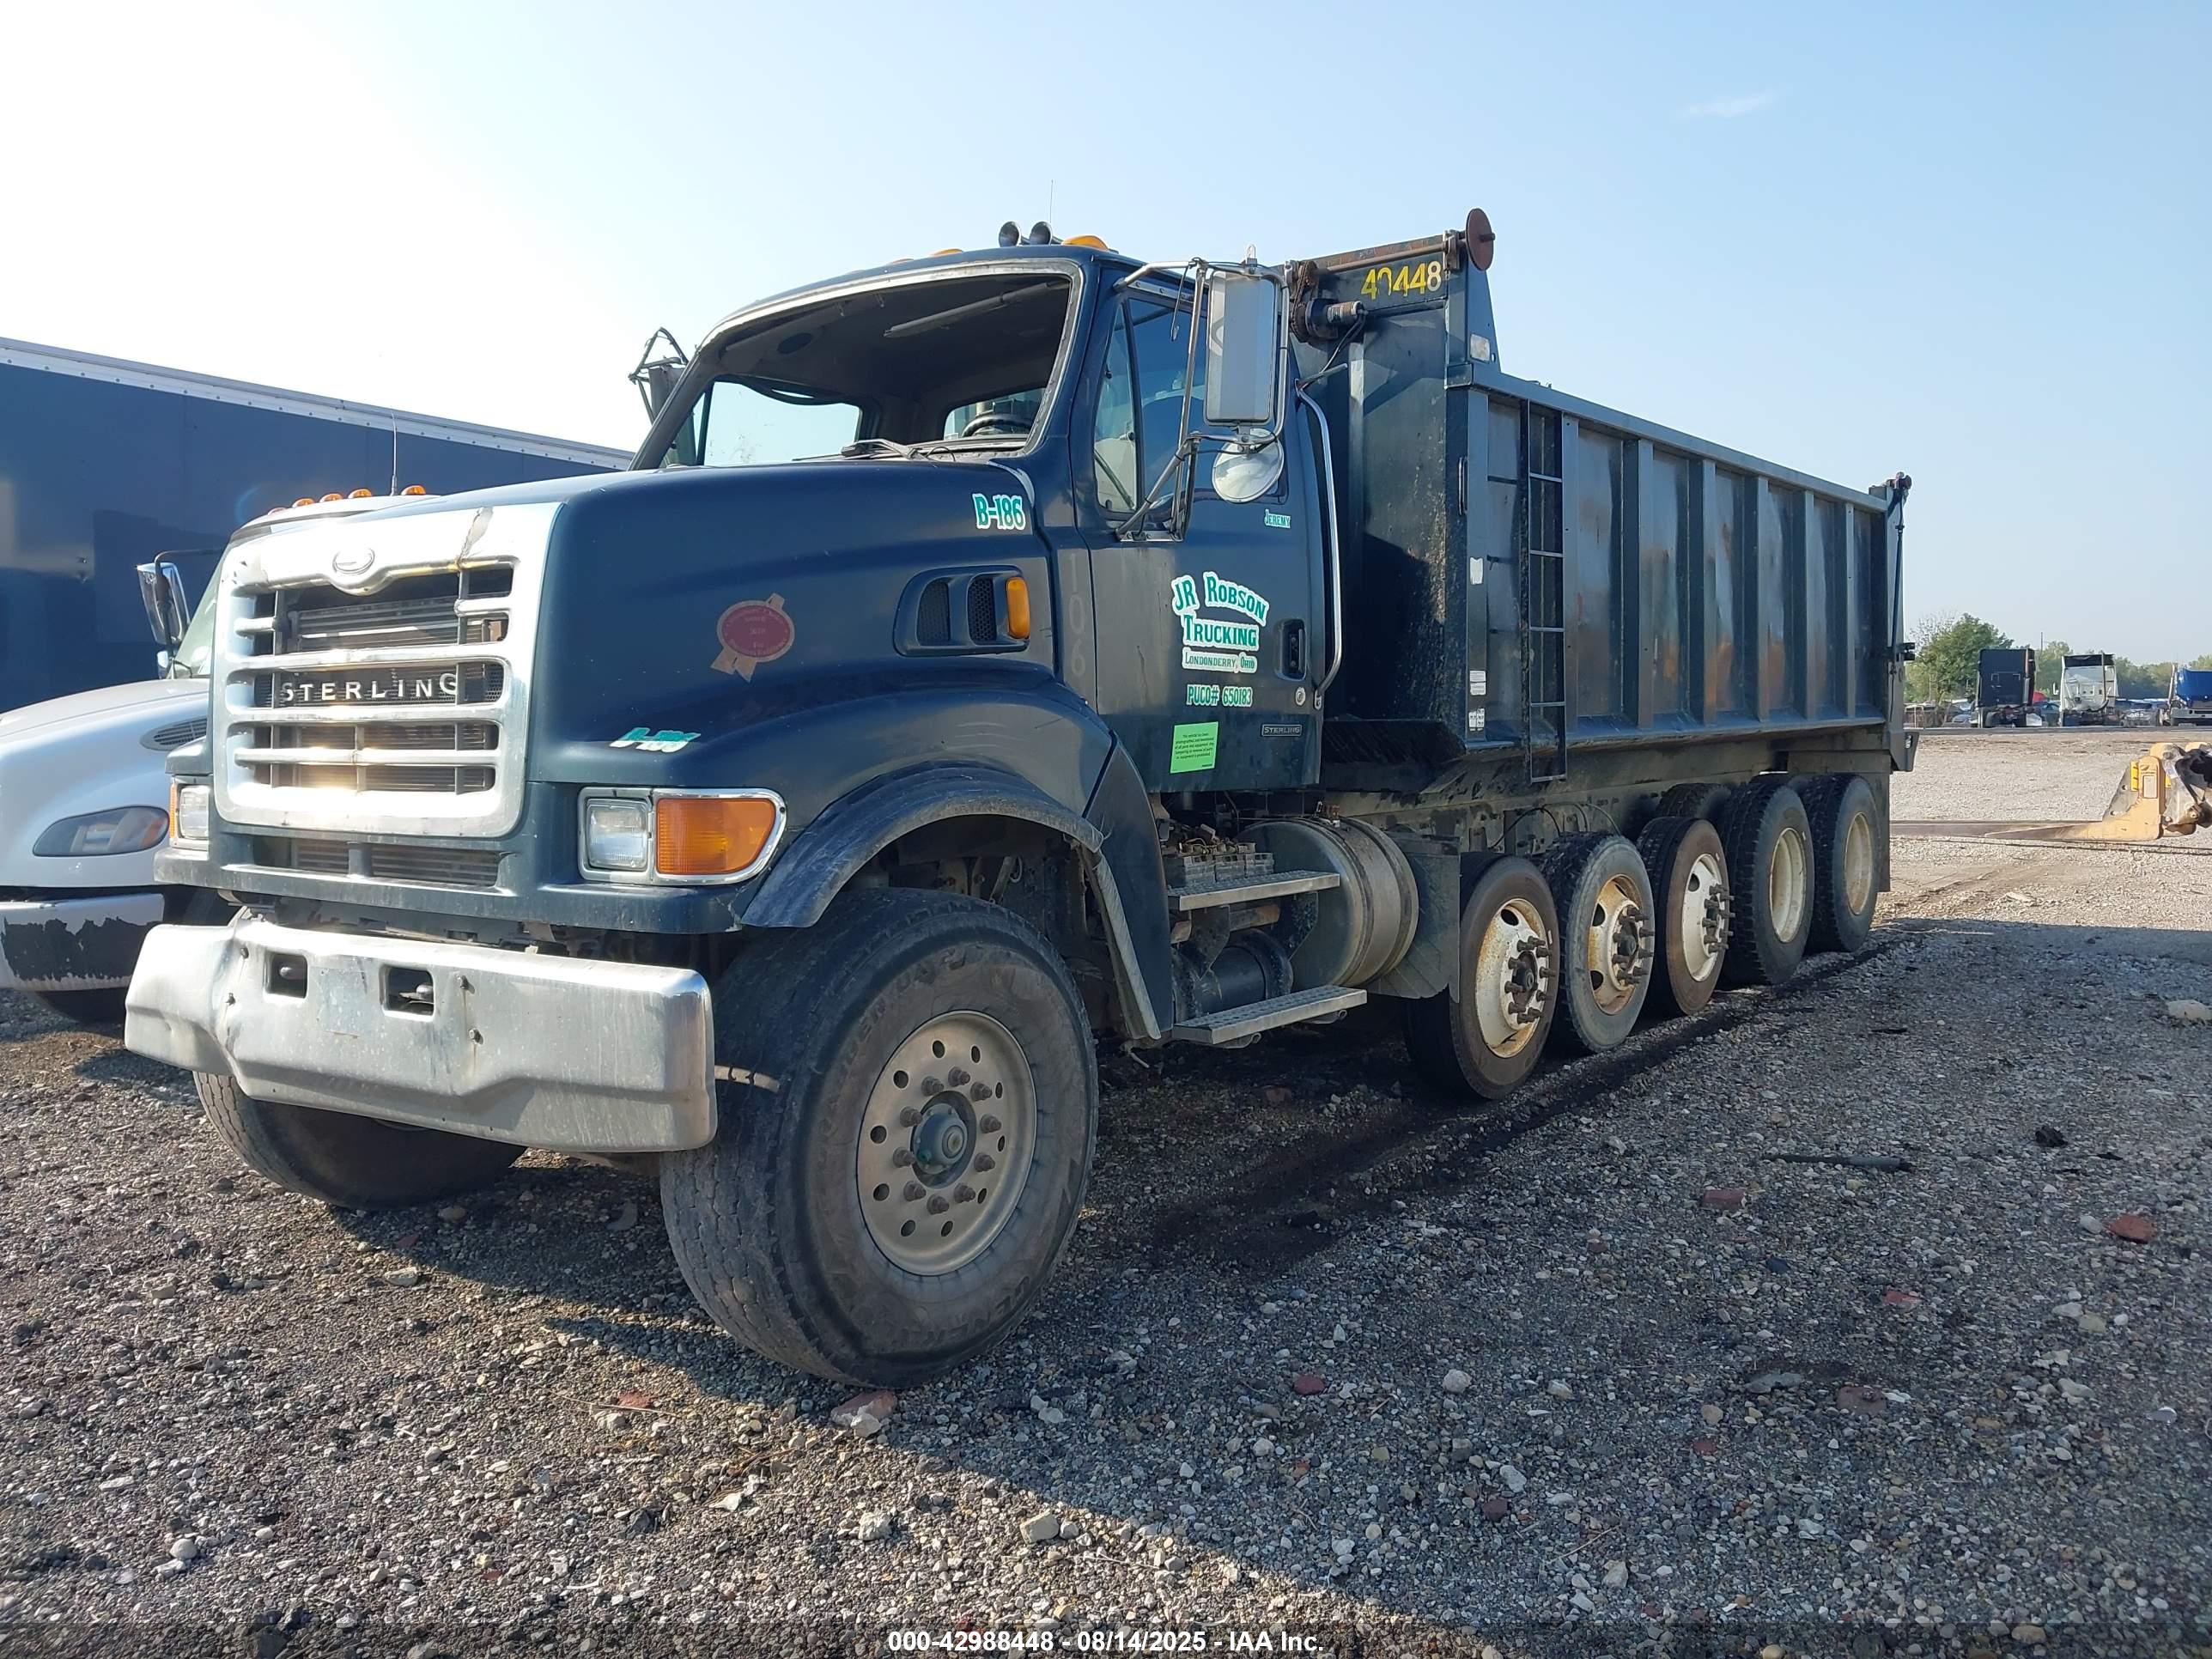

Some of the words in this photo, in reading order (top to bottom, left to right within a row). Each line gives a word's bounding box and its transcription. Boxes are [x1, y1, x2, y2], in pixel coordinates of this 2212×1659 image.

[973, 495, 1025, 529] B-186
[1172, 577, 1199, 613] JR
[282, 673, 458, 702] STERLING
[1187, 685, 1218, 705] PUCO#
[1222, 687, 1252, 706] 650183
[1264, 726, 1301, 734] STERLING
